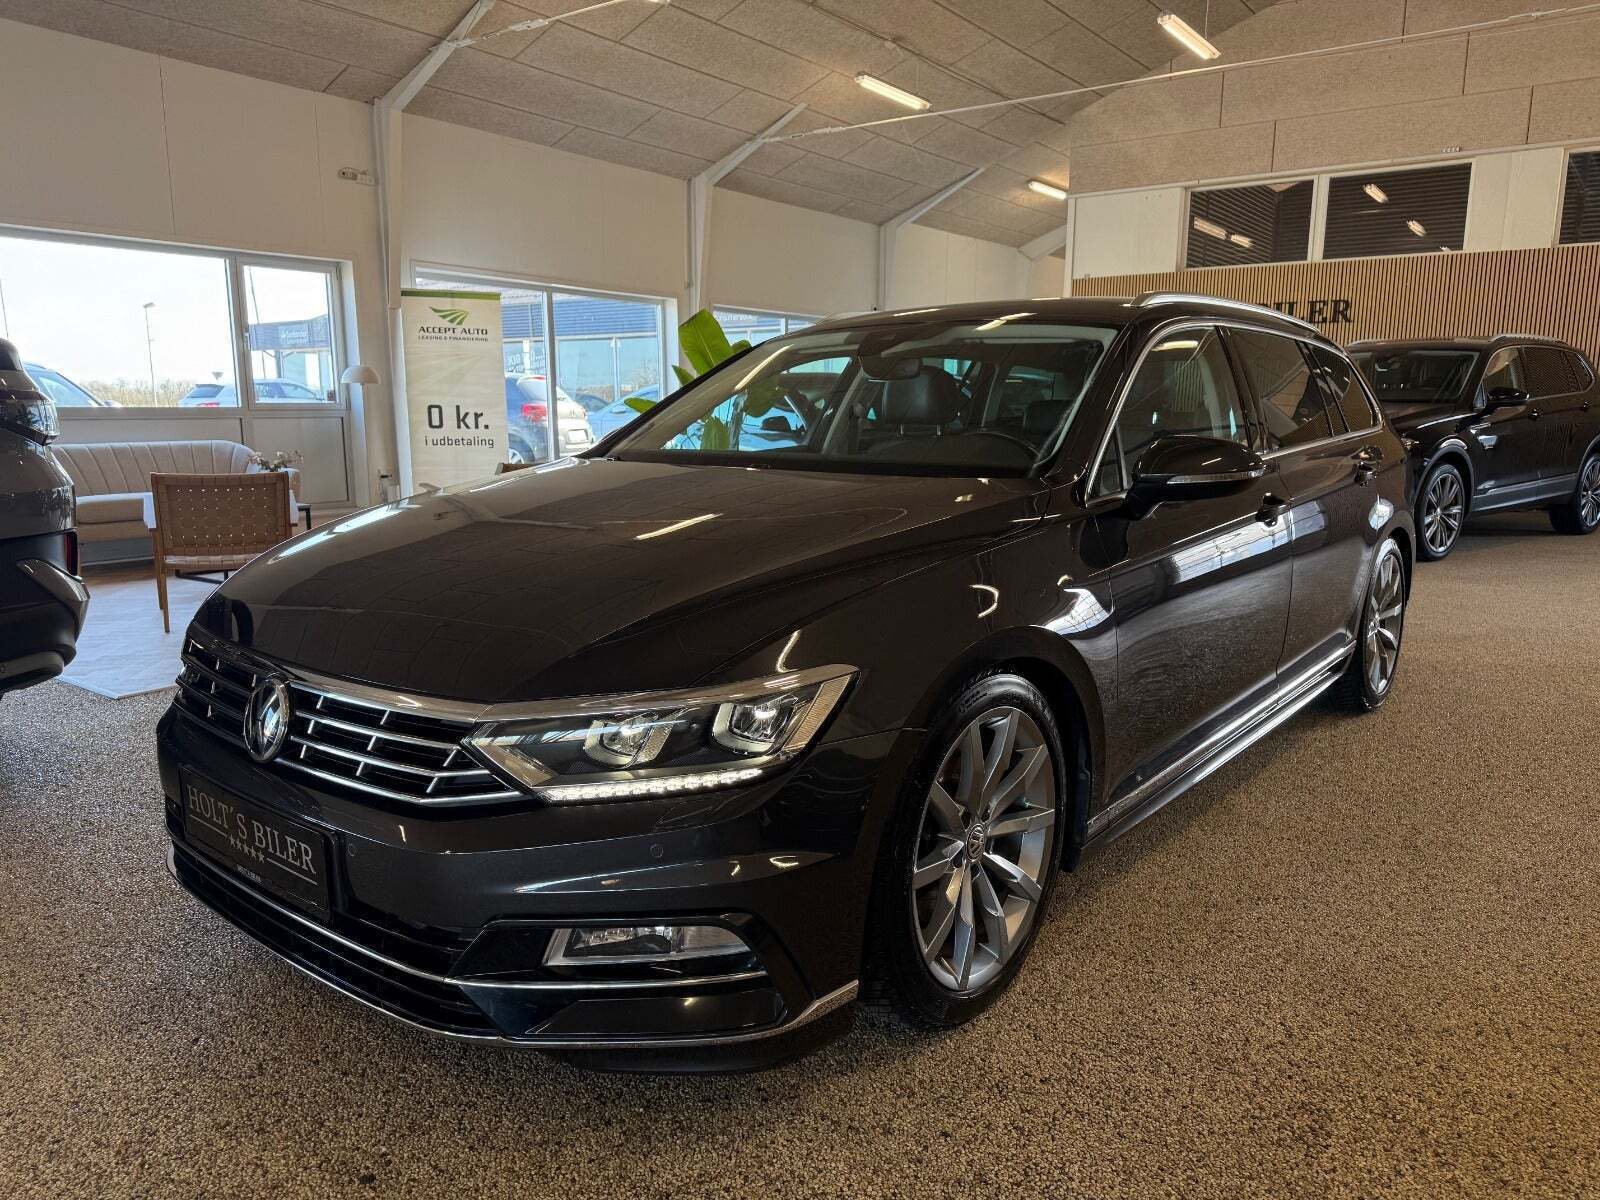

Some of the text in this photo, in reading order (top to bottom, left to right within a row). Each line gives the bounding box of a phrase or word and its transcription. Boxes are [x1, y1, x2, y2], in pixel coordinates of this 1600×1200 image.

[418, 326, 489, 336] ACCEPT AUTO
[427, 404, 489, 430] 0 kr.
[431, 435, 495, 449] udbetaling
[252, 819, 317, 875] BILER
